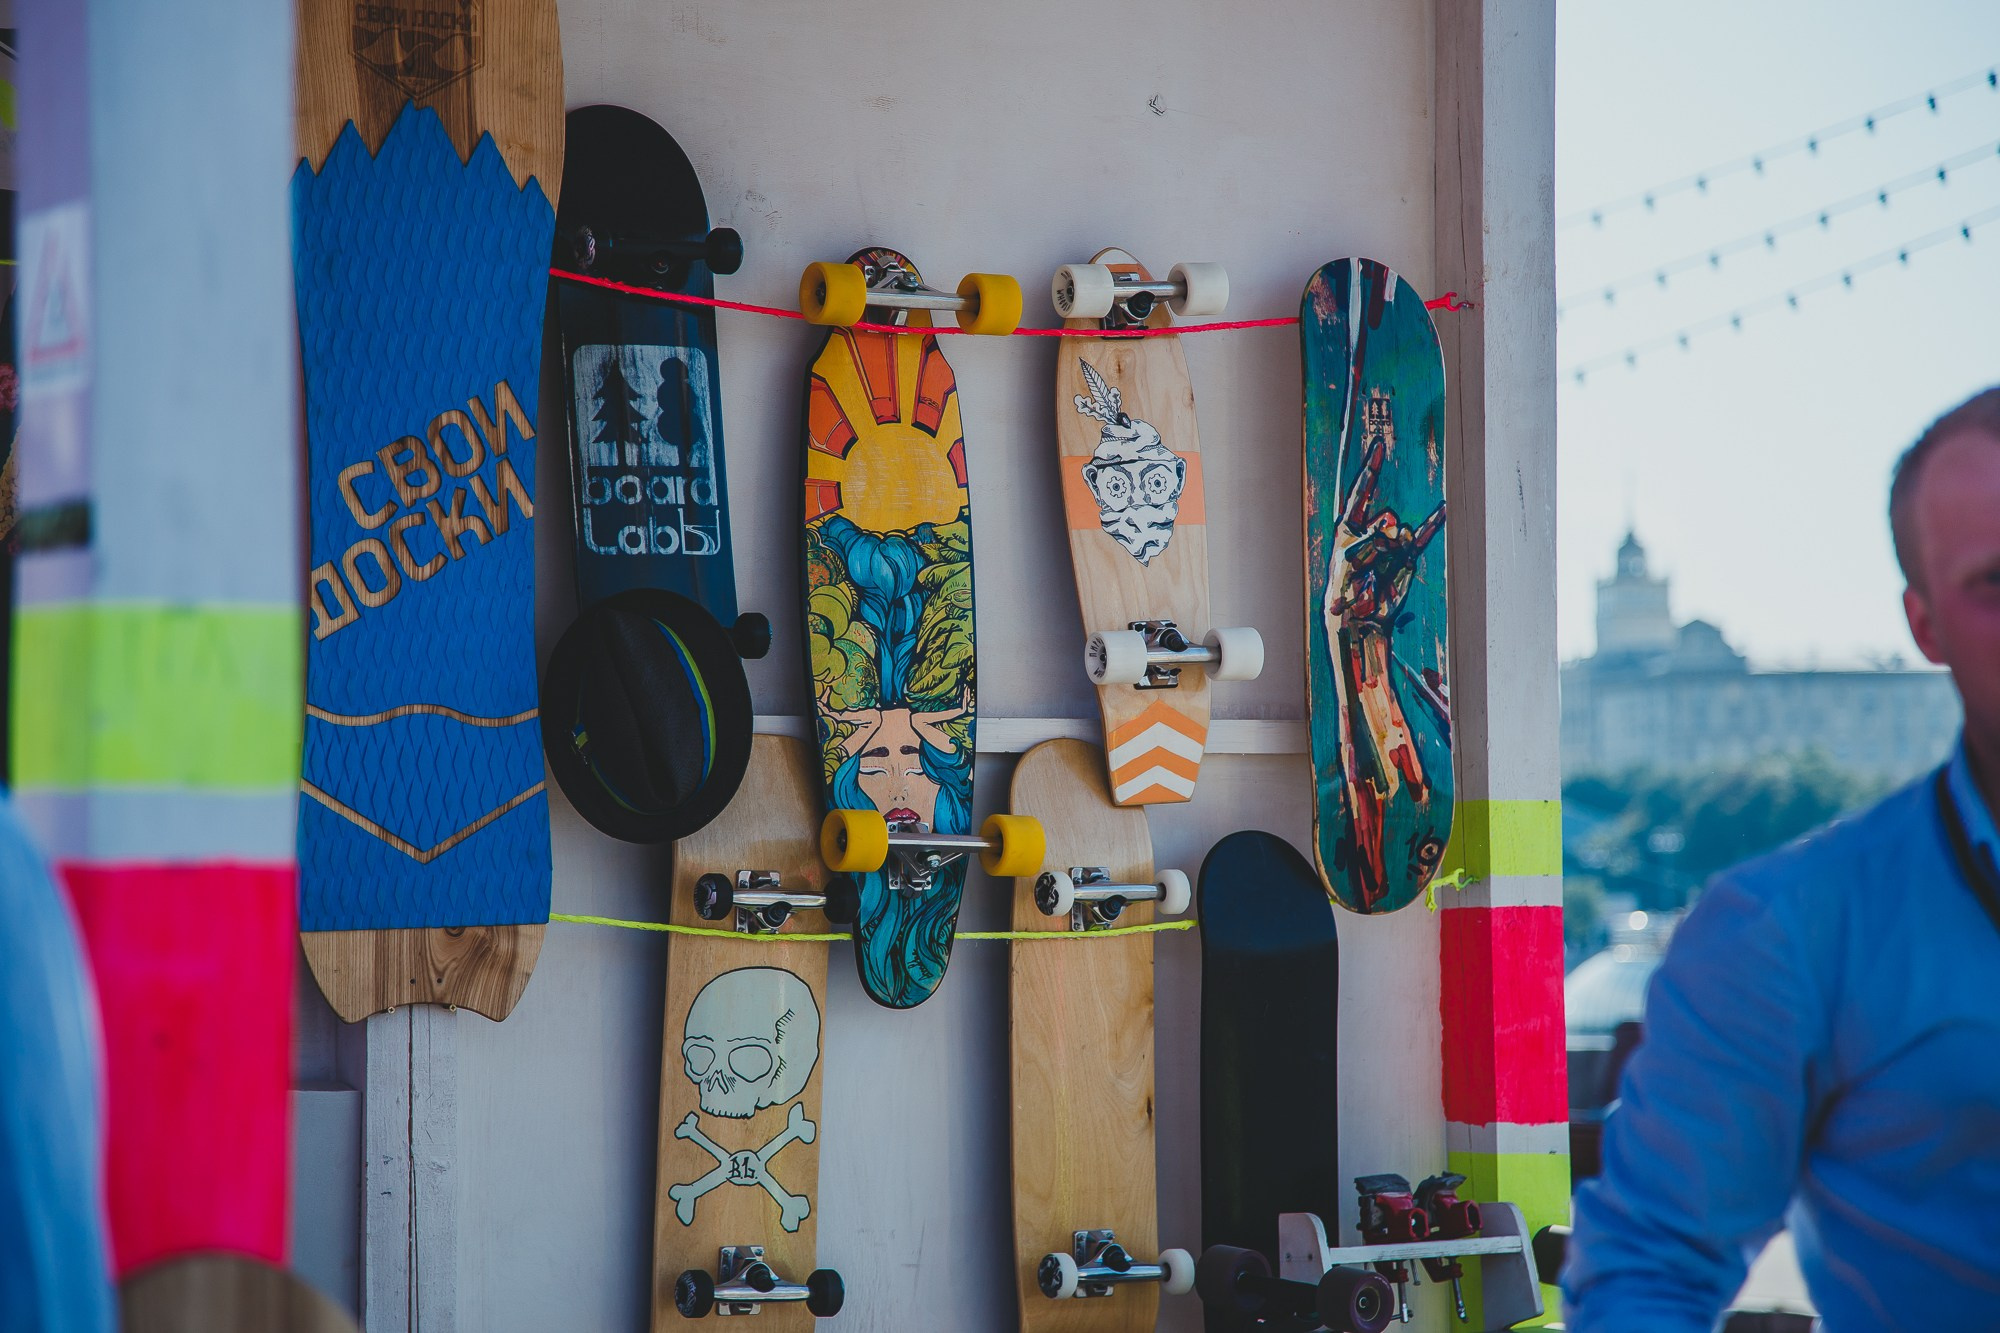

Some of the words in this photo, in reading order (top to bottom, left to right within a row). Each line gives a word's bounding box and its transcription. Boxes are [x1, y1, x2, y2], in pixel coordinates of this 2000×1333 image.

[337, 378, 537, 530] СВОИ
[582, 473, 719, 506] board
[310, 457, 534, 642] ДОСКИ
